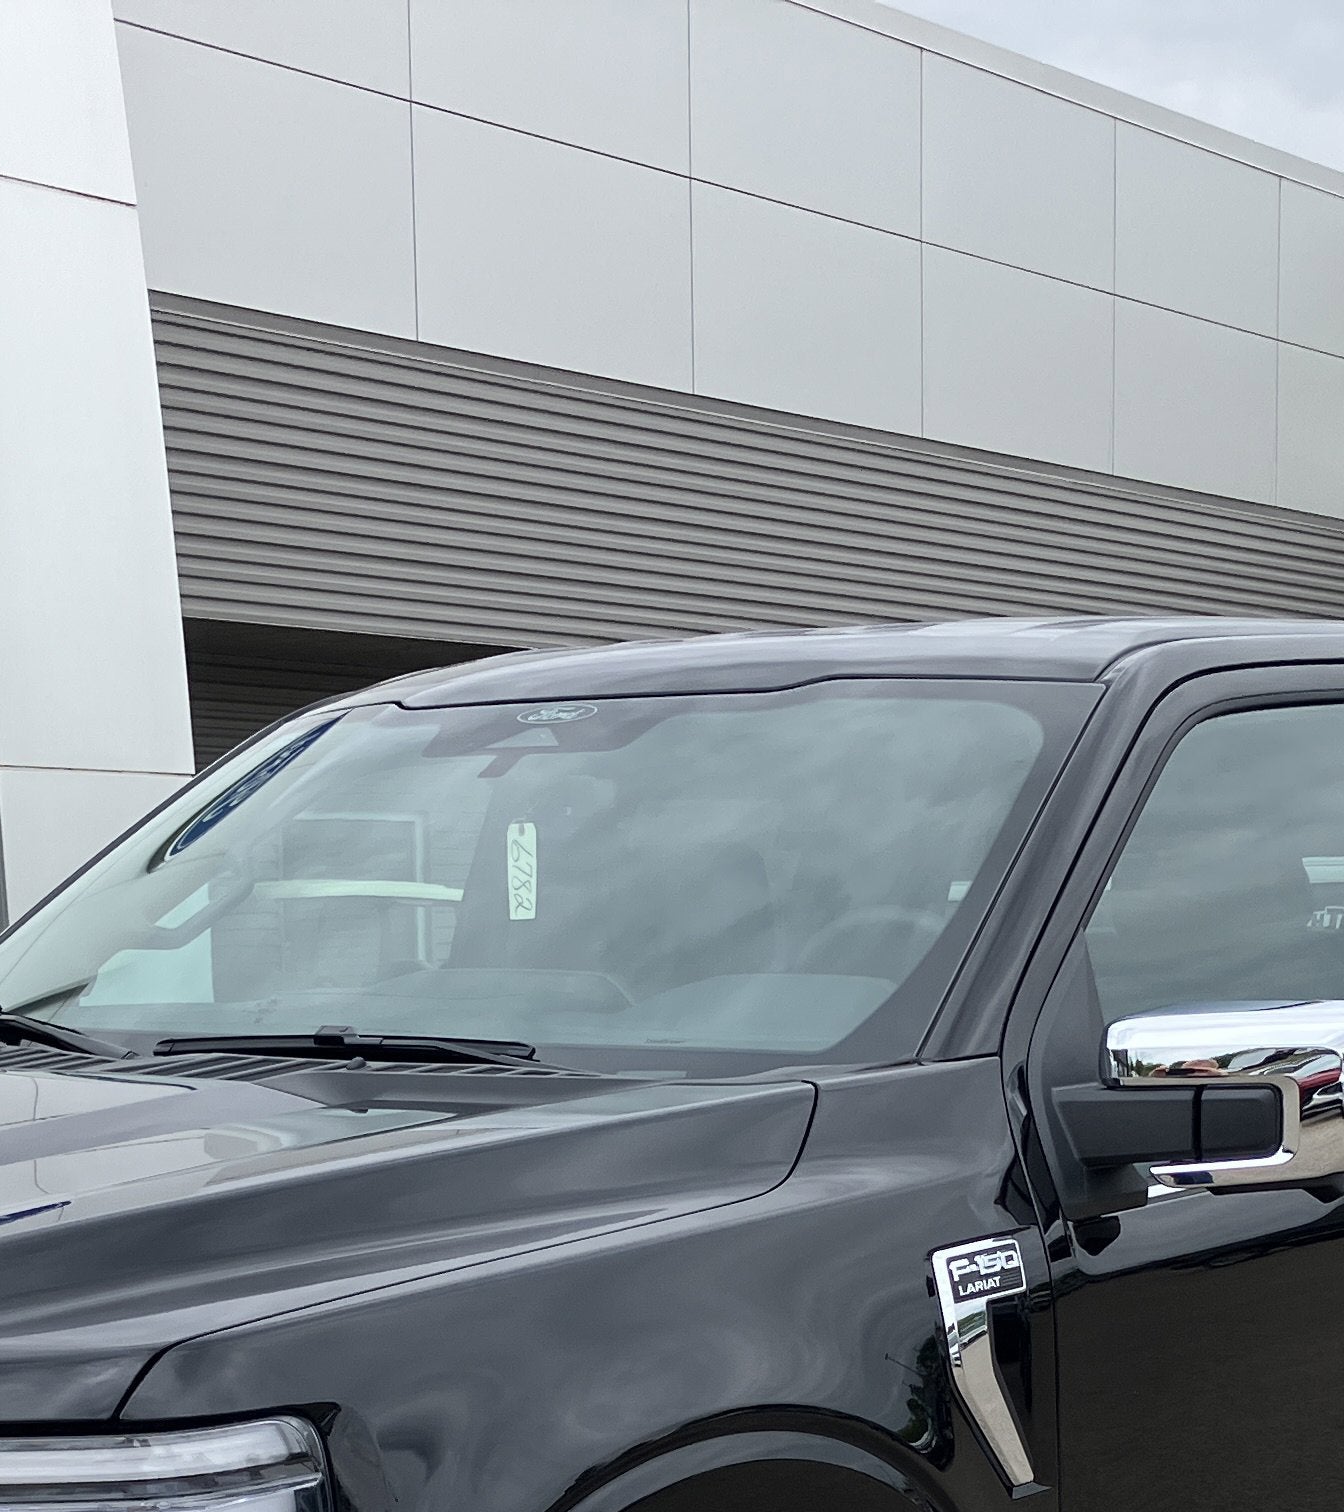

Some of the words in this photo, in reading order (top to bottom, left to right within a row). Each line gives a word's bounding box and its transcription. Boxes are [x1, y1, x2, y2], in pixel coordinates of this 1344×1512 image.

[511, 839, 534, 917] 6782
[949, 1250, 1021, 1281] F-150
[959, 1276, 1001, 1296] LARIAT
